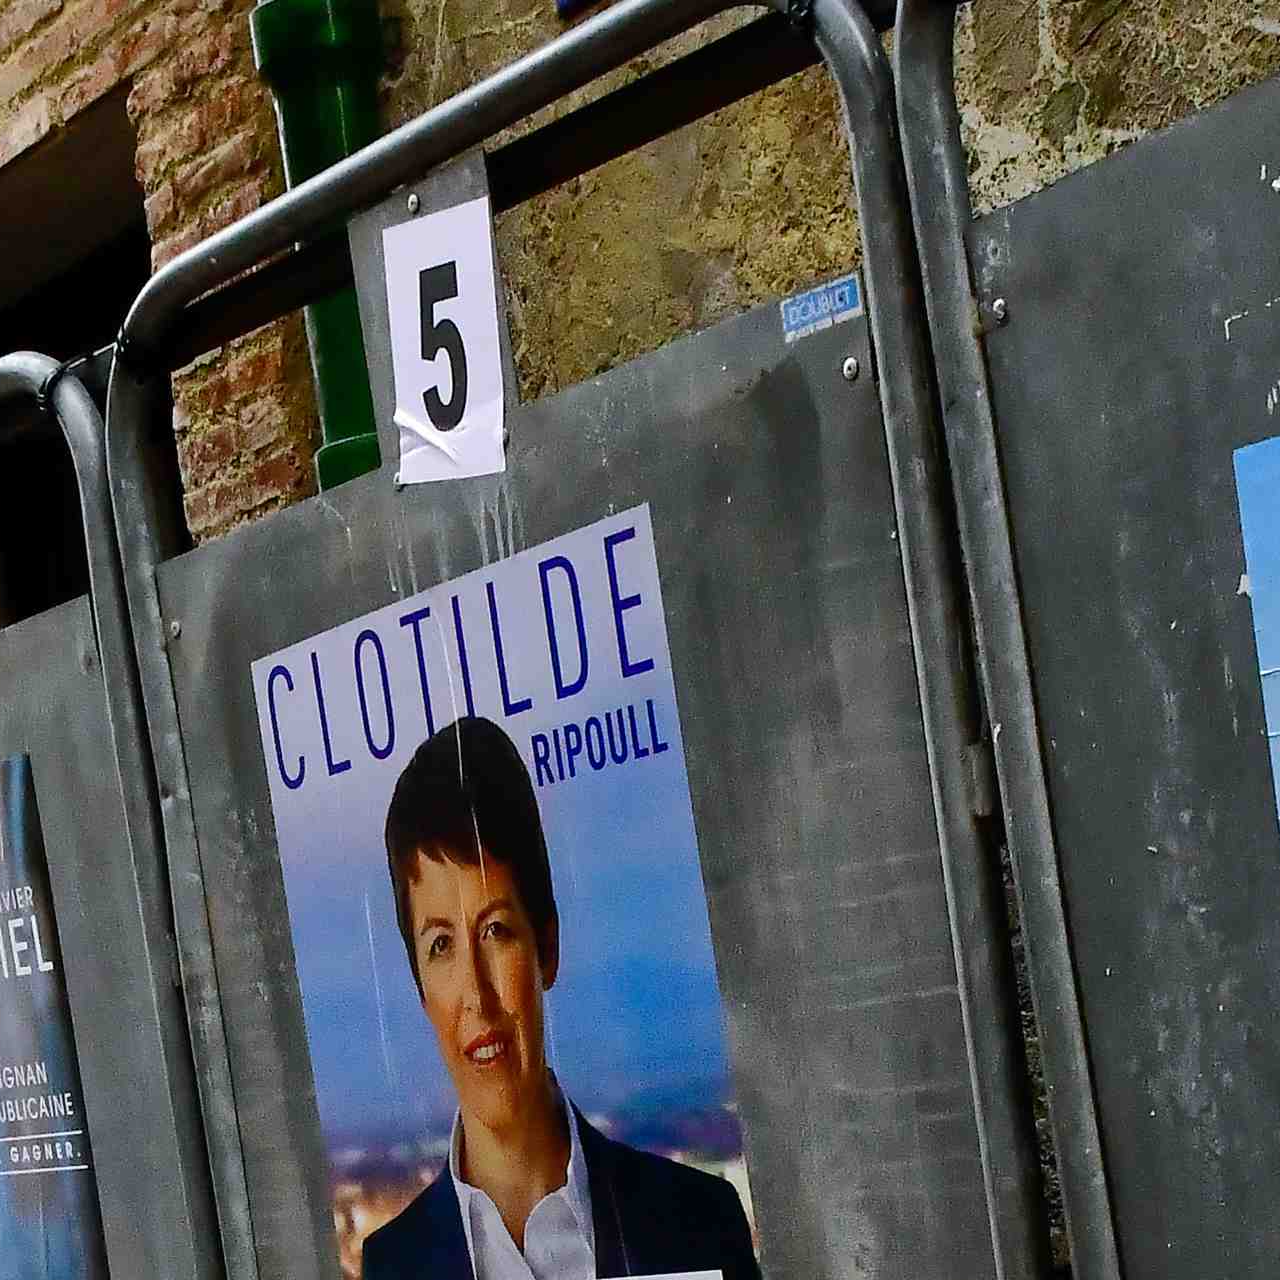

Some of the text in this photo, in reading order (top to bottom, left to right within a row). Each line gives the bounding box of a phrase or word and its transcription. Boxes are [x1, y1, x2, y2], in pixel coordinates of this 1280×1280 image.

[417, 260, 469, 432] 5
[266, 526, 655, 790] CLOTILDE
[529, 699, 670, 787] RIPOULL
[10, 1140, 82, 1163] GAGNER.
